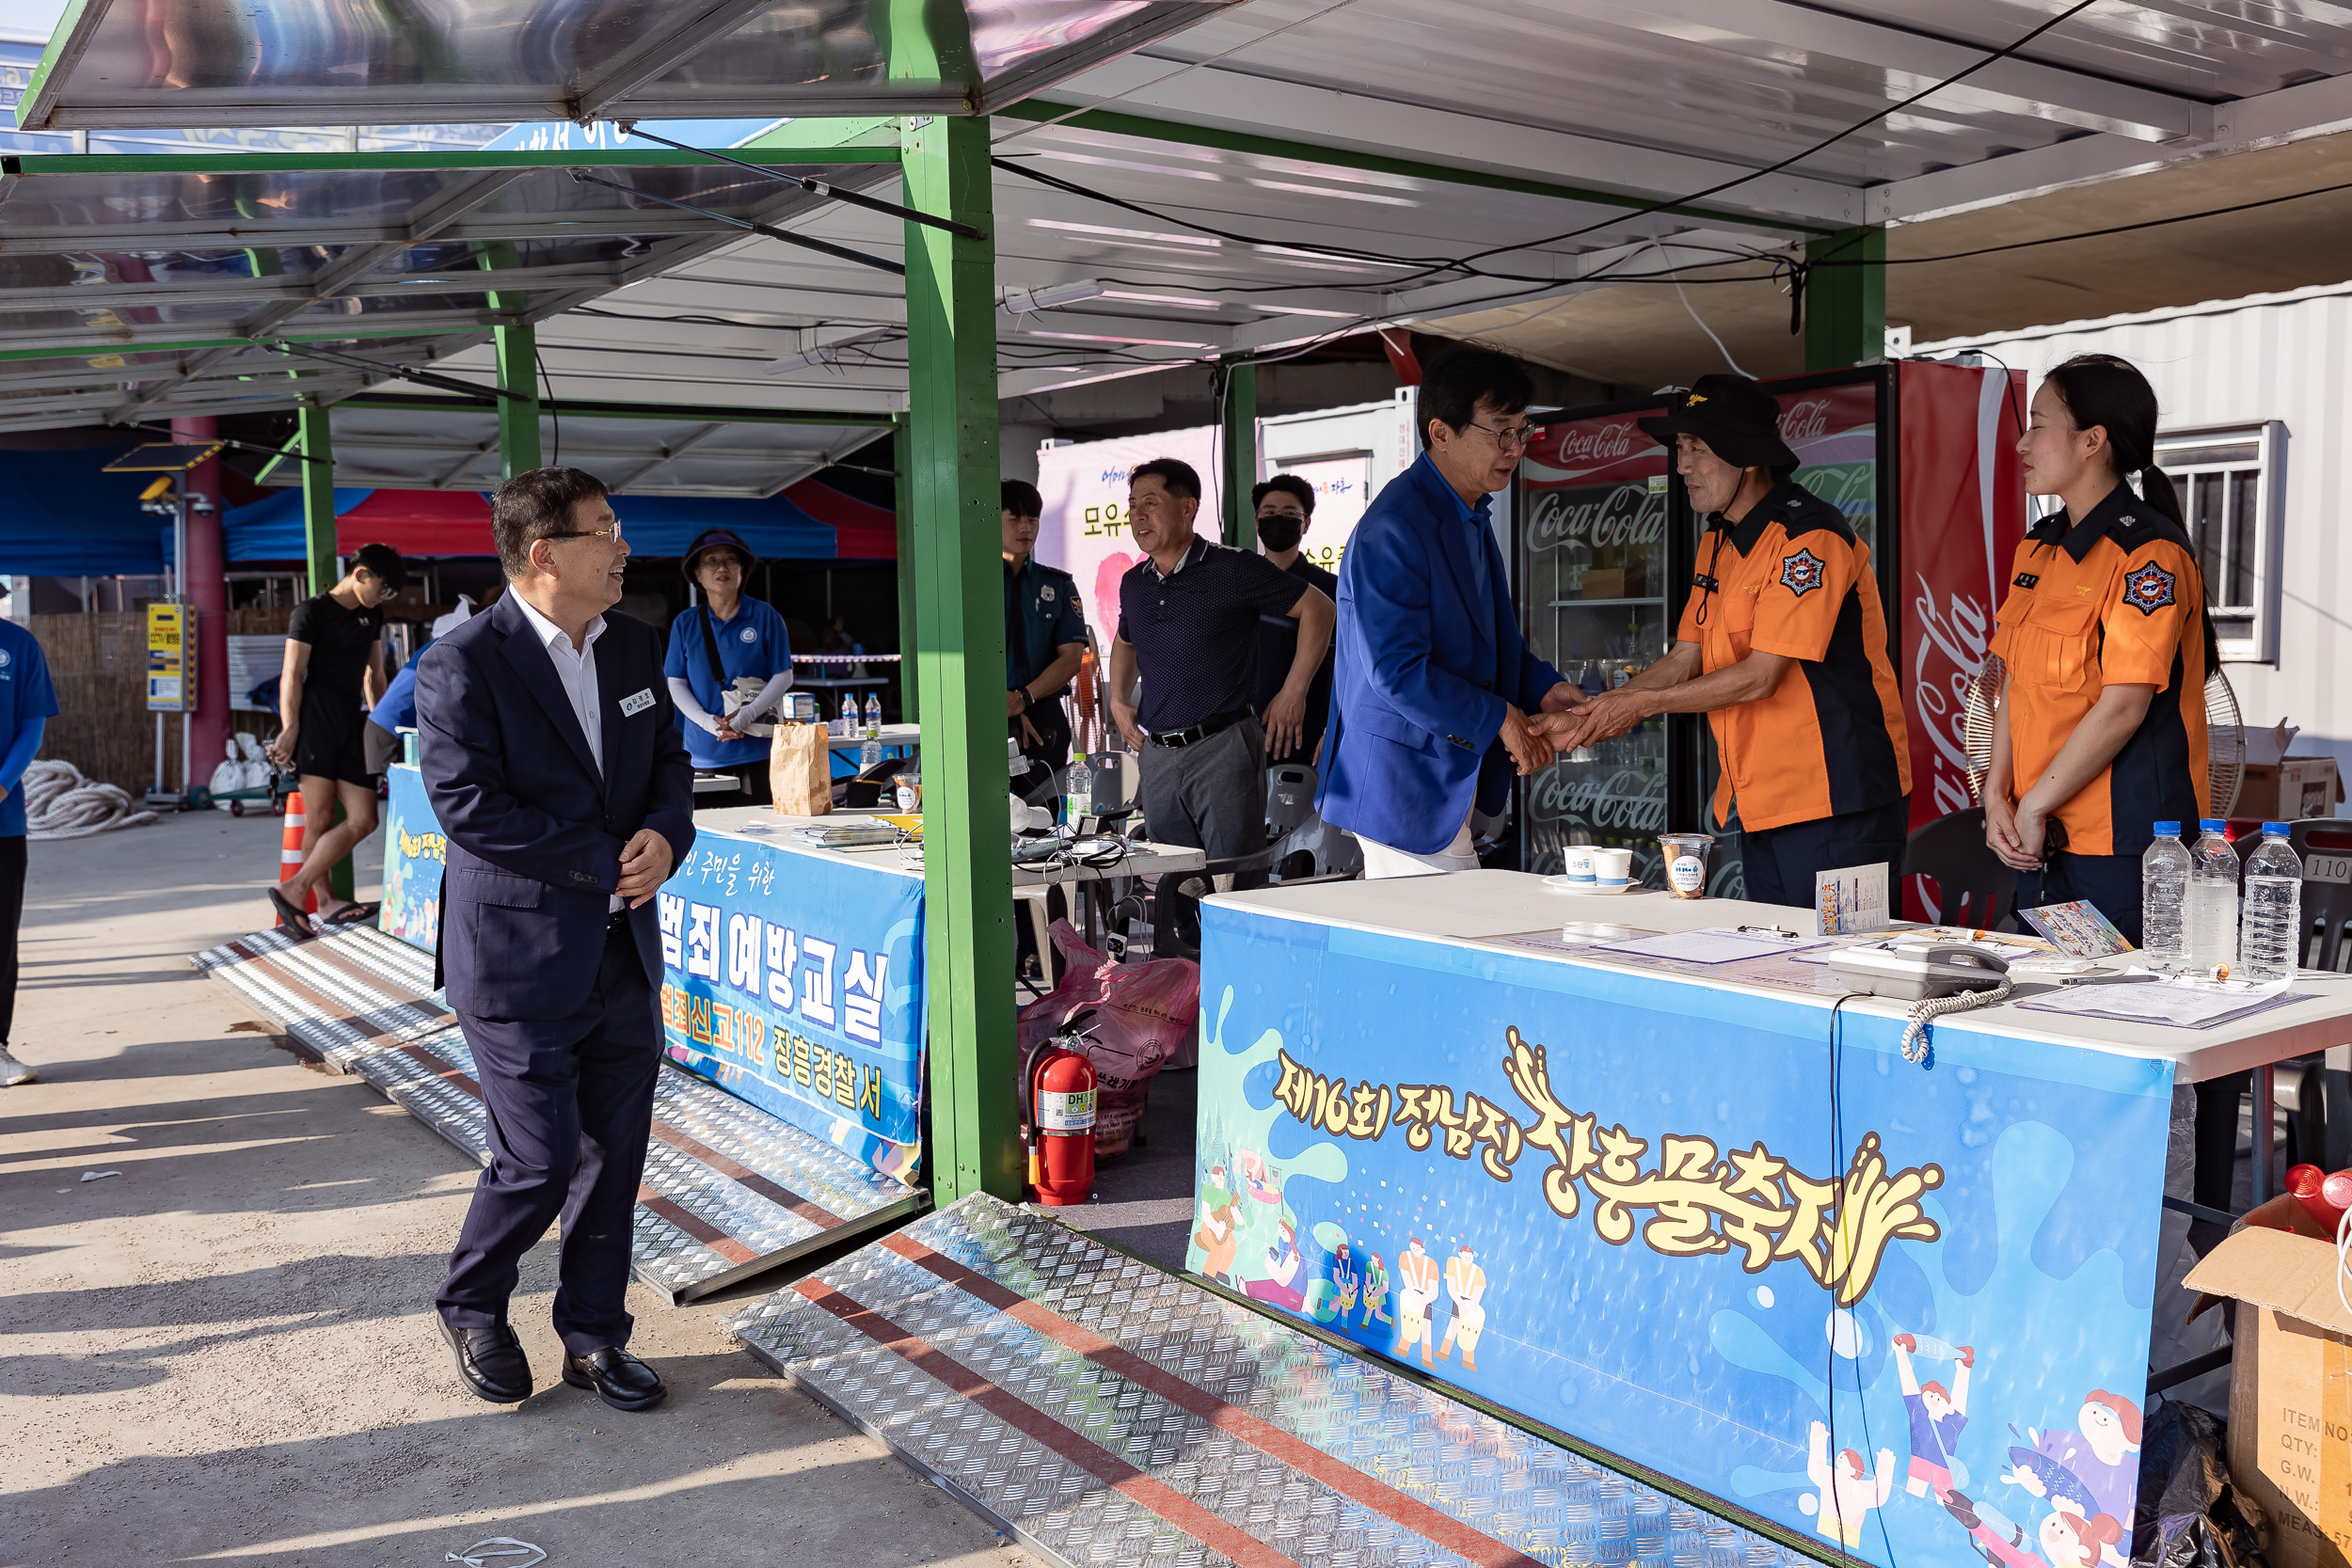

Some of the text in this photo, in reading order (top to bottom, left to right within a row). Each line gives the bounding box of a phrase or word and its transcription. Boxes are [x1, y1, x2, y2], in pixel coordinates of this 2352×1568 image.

[1559, 421, 1634, 464] Coca-Cola
[1526, 484, 1666, 553] Coca-Cola
[1527, 766, 1667, 833] Coca-Cola
[675, 849, 775, 896] 인 주민을 위한
[2312, 859, 2347, 879] 110
[659, 892, 890, 1049] 범죄 예방교실
[660, 982, 882, 1121] 범죄신고112 장흥경찰서
[1068, 1094, 1084, 1105] DH
[1273, 1048, 1392, 1142] 제16회
[1393, 1083, 1523, 1183] 정남진
[2282, 1407, 2320, 1433] ITEM
[2281, 1433, 2318, 1458] QTY:
[2280, 1460, 2315, 1483] G.W.
[2278, 1511, 2328, 1542] MEAS:
